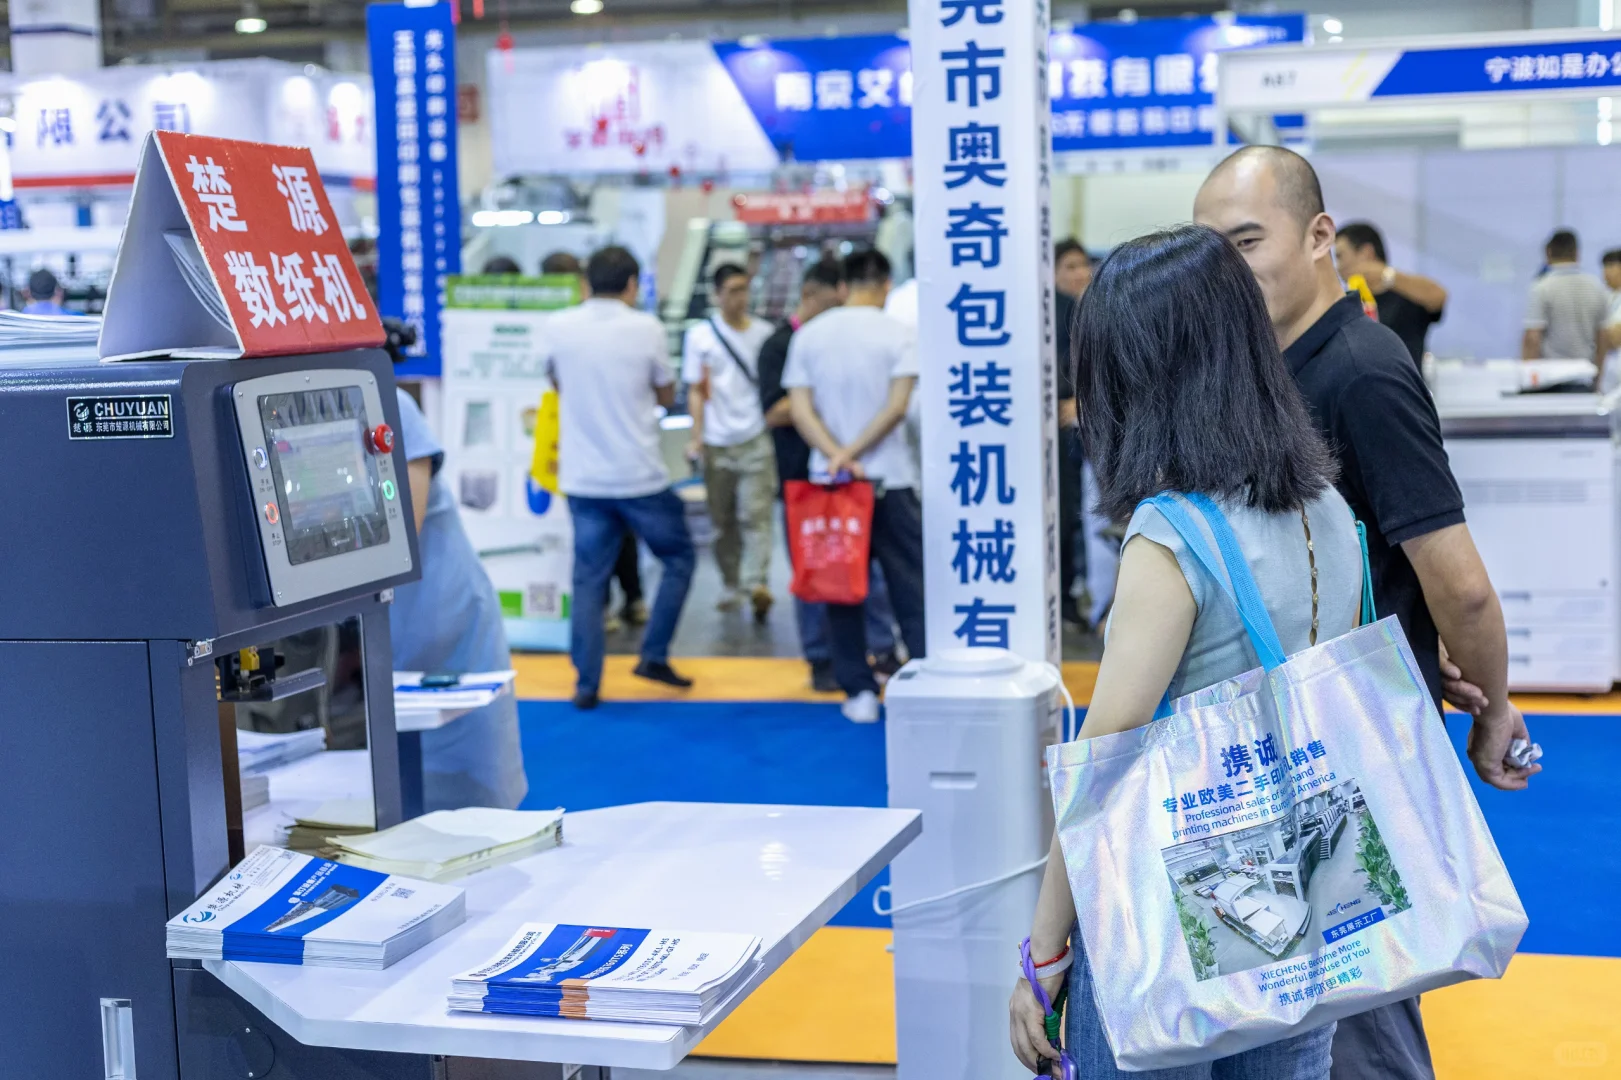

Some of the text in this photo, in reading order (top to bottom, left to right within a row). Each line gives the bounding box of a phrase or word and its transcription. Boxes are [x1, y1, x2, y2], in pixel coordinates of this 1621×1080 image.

[185, 154, 329, 236] 楚源
[223, 250, 368, 329] 数纸机
[94, 401, 169, 416] CHUYUAN
[1162, 739, 1328, 814] 专业欧美二手印机销售
[1220, 732, 1280, 778] 携诚
[1172, 823, 1210, 841] printing
[1211, 810, 1259, 831] machines
[1260, 807, 1270, 817] in
[1297, 772, 1336, 795] America
[1185, 801, 1245, 822] Professional
[1246, 795, 1271, 809] sales
[1271, 788, 1281, 801] of
[1331, 911, 1378, 939] 东莞展示工厂
[1258, 946, 1371, 993] Wonderful Because Of You
[1260, 939, 1362, 982] XIECHENG Become More
[1278, 965, 1363, 1007] 携诚有你更精彩
